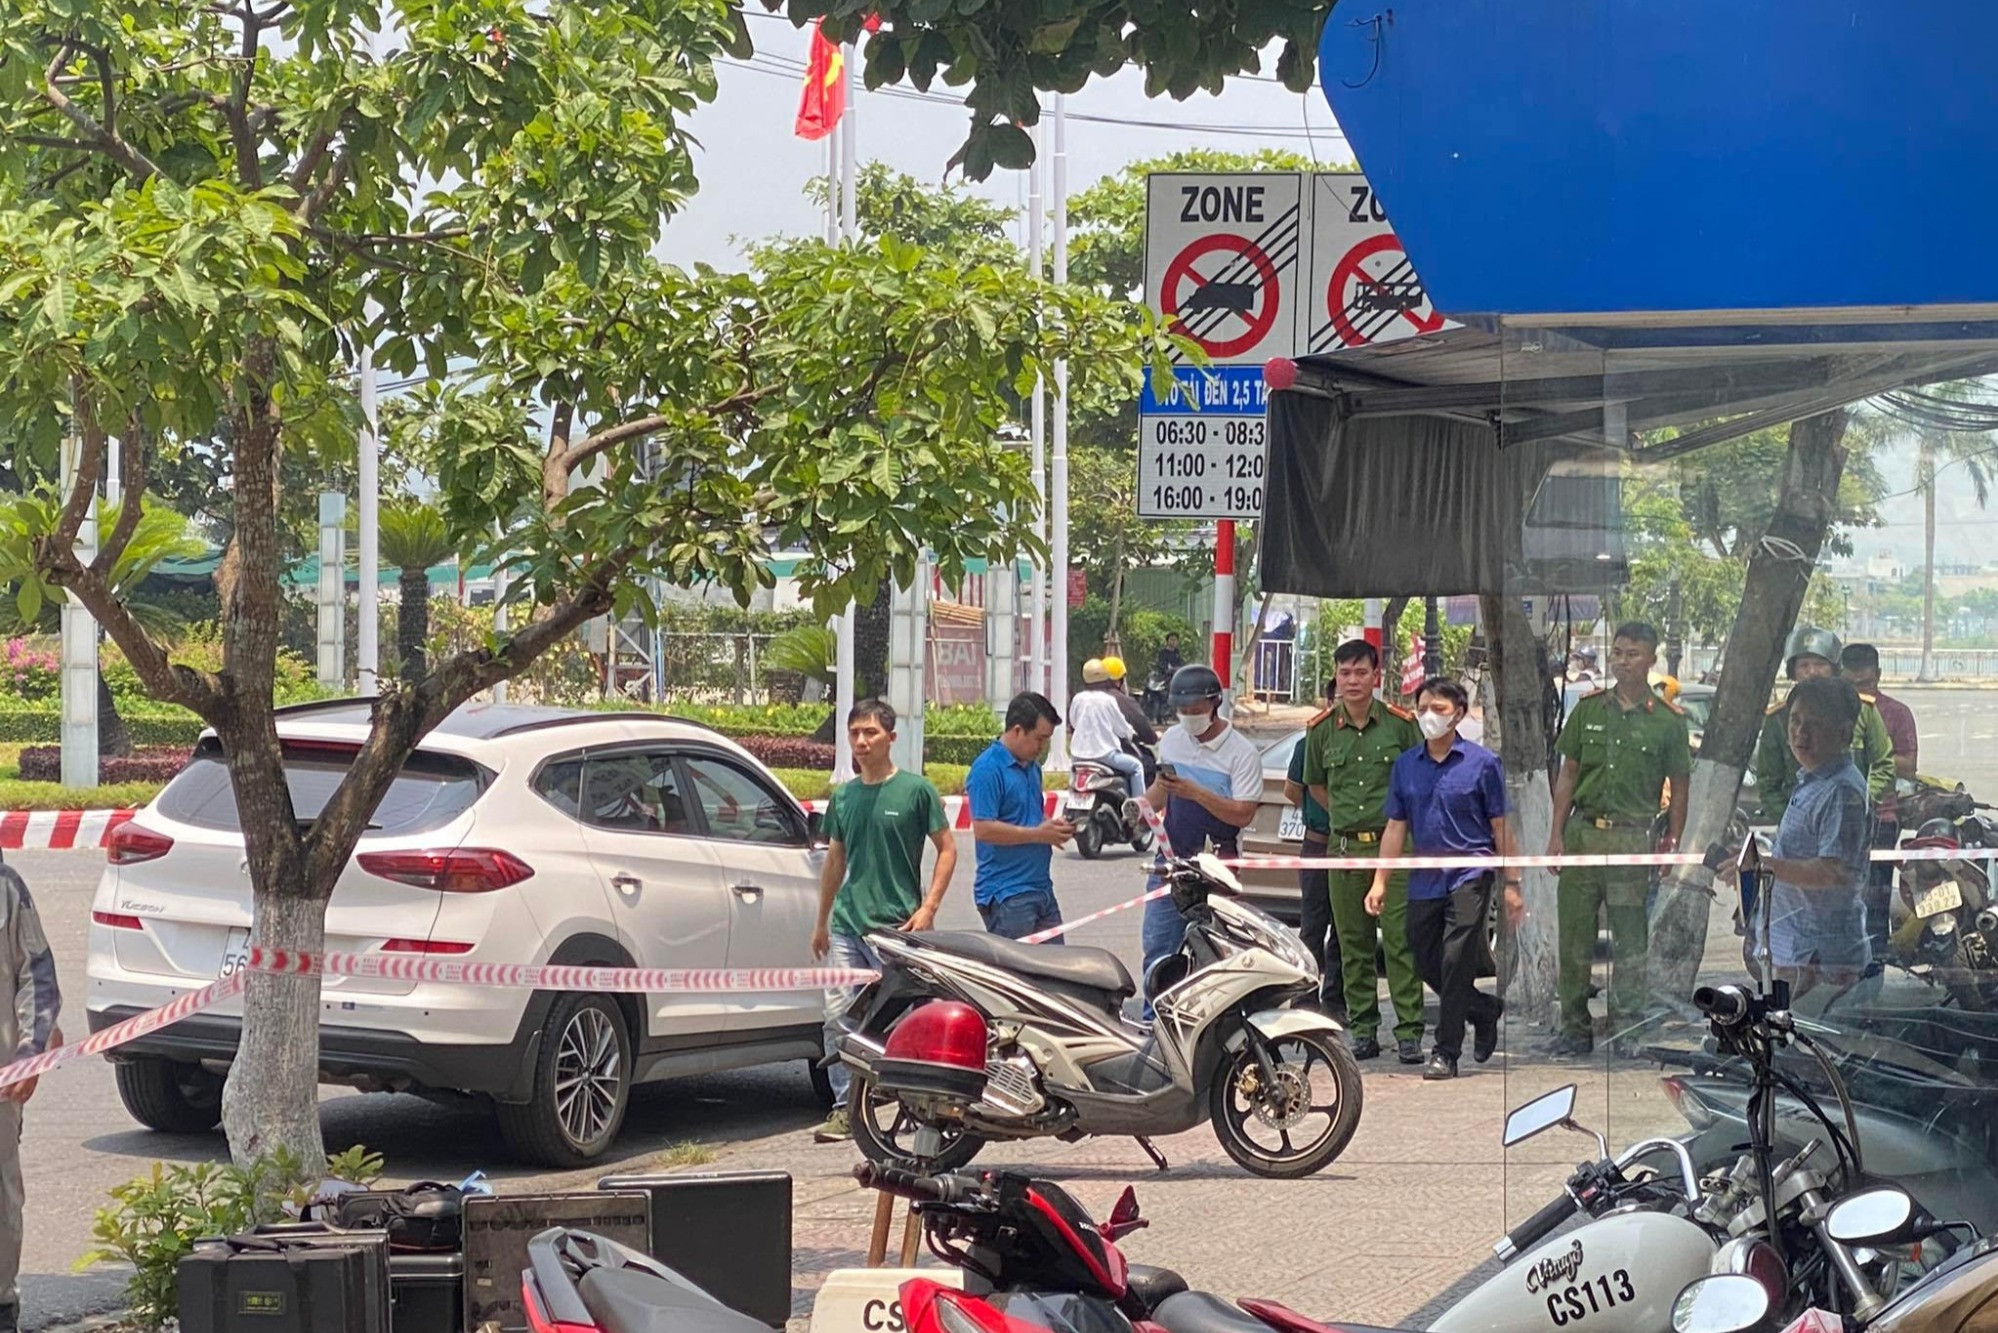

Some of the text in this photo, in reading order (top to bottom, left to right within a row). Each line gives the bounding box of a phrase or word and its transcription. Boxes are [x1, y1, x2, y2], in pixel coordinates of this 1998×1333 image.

[1180, 186, 1265, 222] ZONE
[1232, 380, 1250, 411] 2,5
[1156, 421, 1206, 445] 06:30
[1155, 453, 1205, 477] 11:00
[1225, 454, 1264, 478] 12:0
[1153, 485, 1203, 510] 16:00
[1224, 486, 1262, 510] 19:0
[1547, 1268, 1635, 1327] CS113
[863, 1299, 905, 1332] CS
